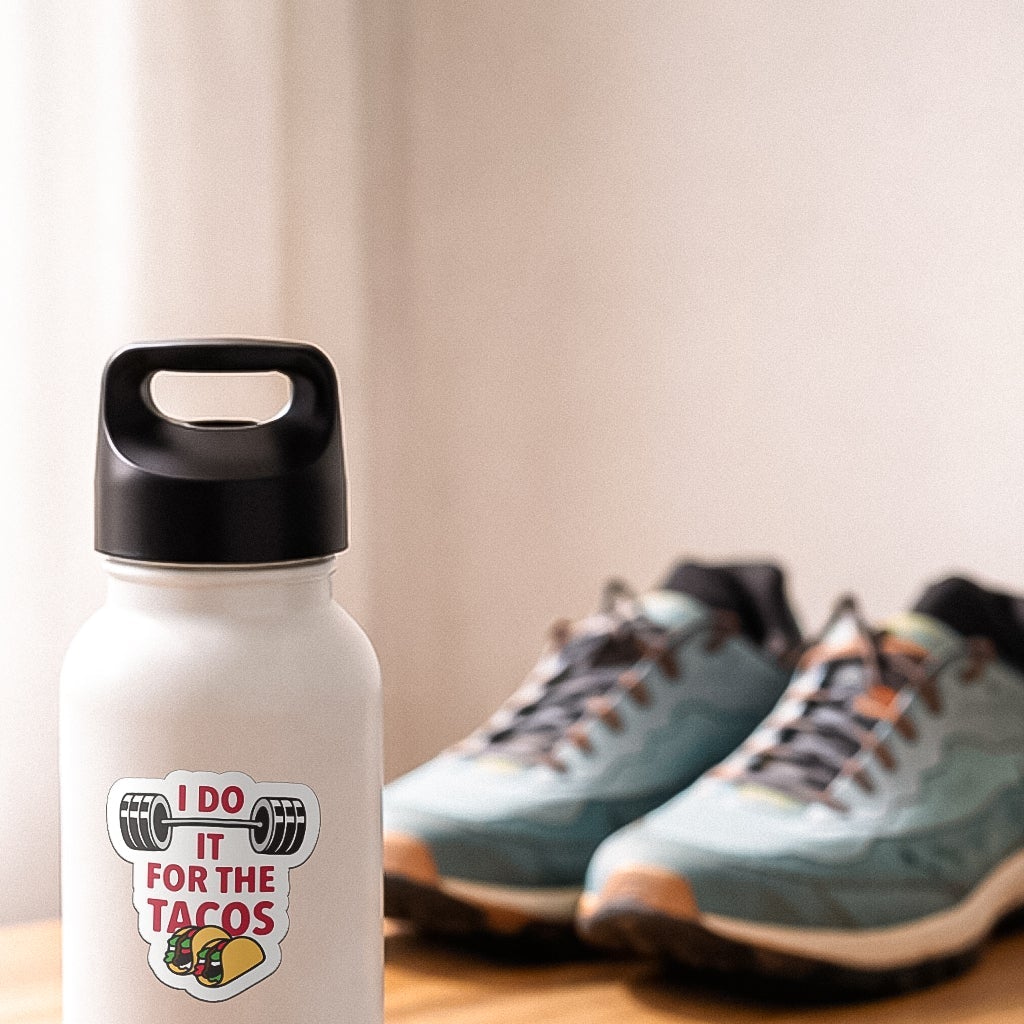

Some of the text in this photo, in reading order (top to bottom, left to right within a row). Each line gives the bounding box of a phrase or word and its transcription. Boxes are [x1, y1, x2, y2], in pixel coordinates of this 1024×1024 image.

[178, 784, 245, 814] I DO
[196, 832, 225, 860] IT
[146, 862, 275, 894] FOR THE
[146, 897, 275, 937] TACOS
